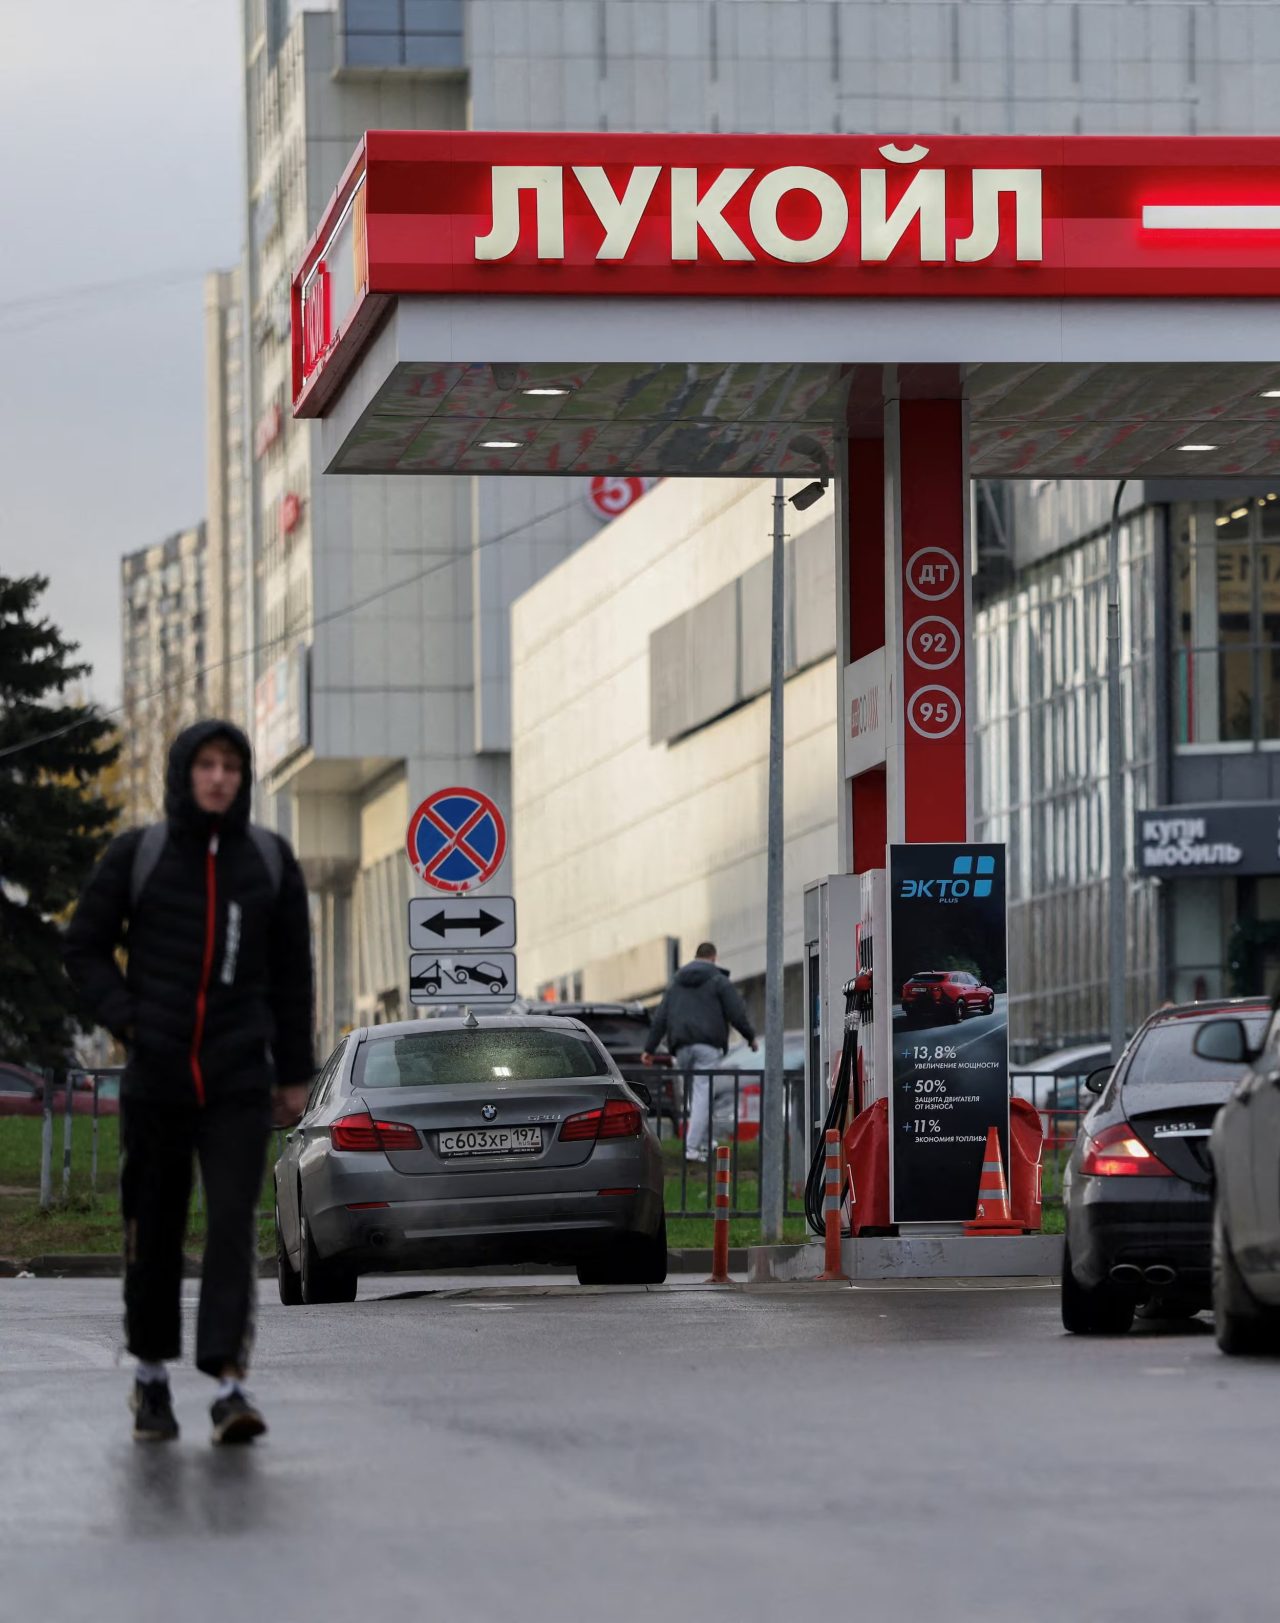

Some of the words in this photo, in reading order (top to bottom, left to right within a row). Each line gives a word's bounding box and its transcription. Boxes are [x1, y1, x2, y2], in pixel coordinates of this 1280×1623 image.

[474, 143, 1043, 263] ЛУКОЙЛ
[918, 564, 949, 585] ДТ
[919, 632, 947, 653] 92
[919, 702, 949, 723] 95
[900, 879, 970, 898] ЭКТО
[512, 1128, 536, 1141] 197
